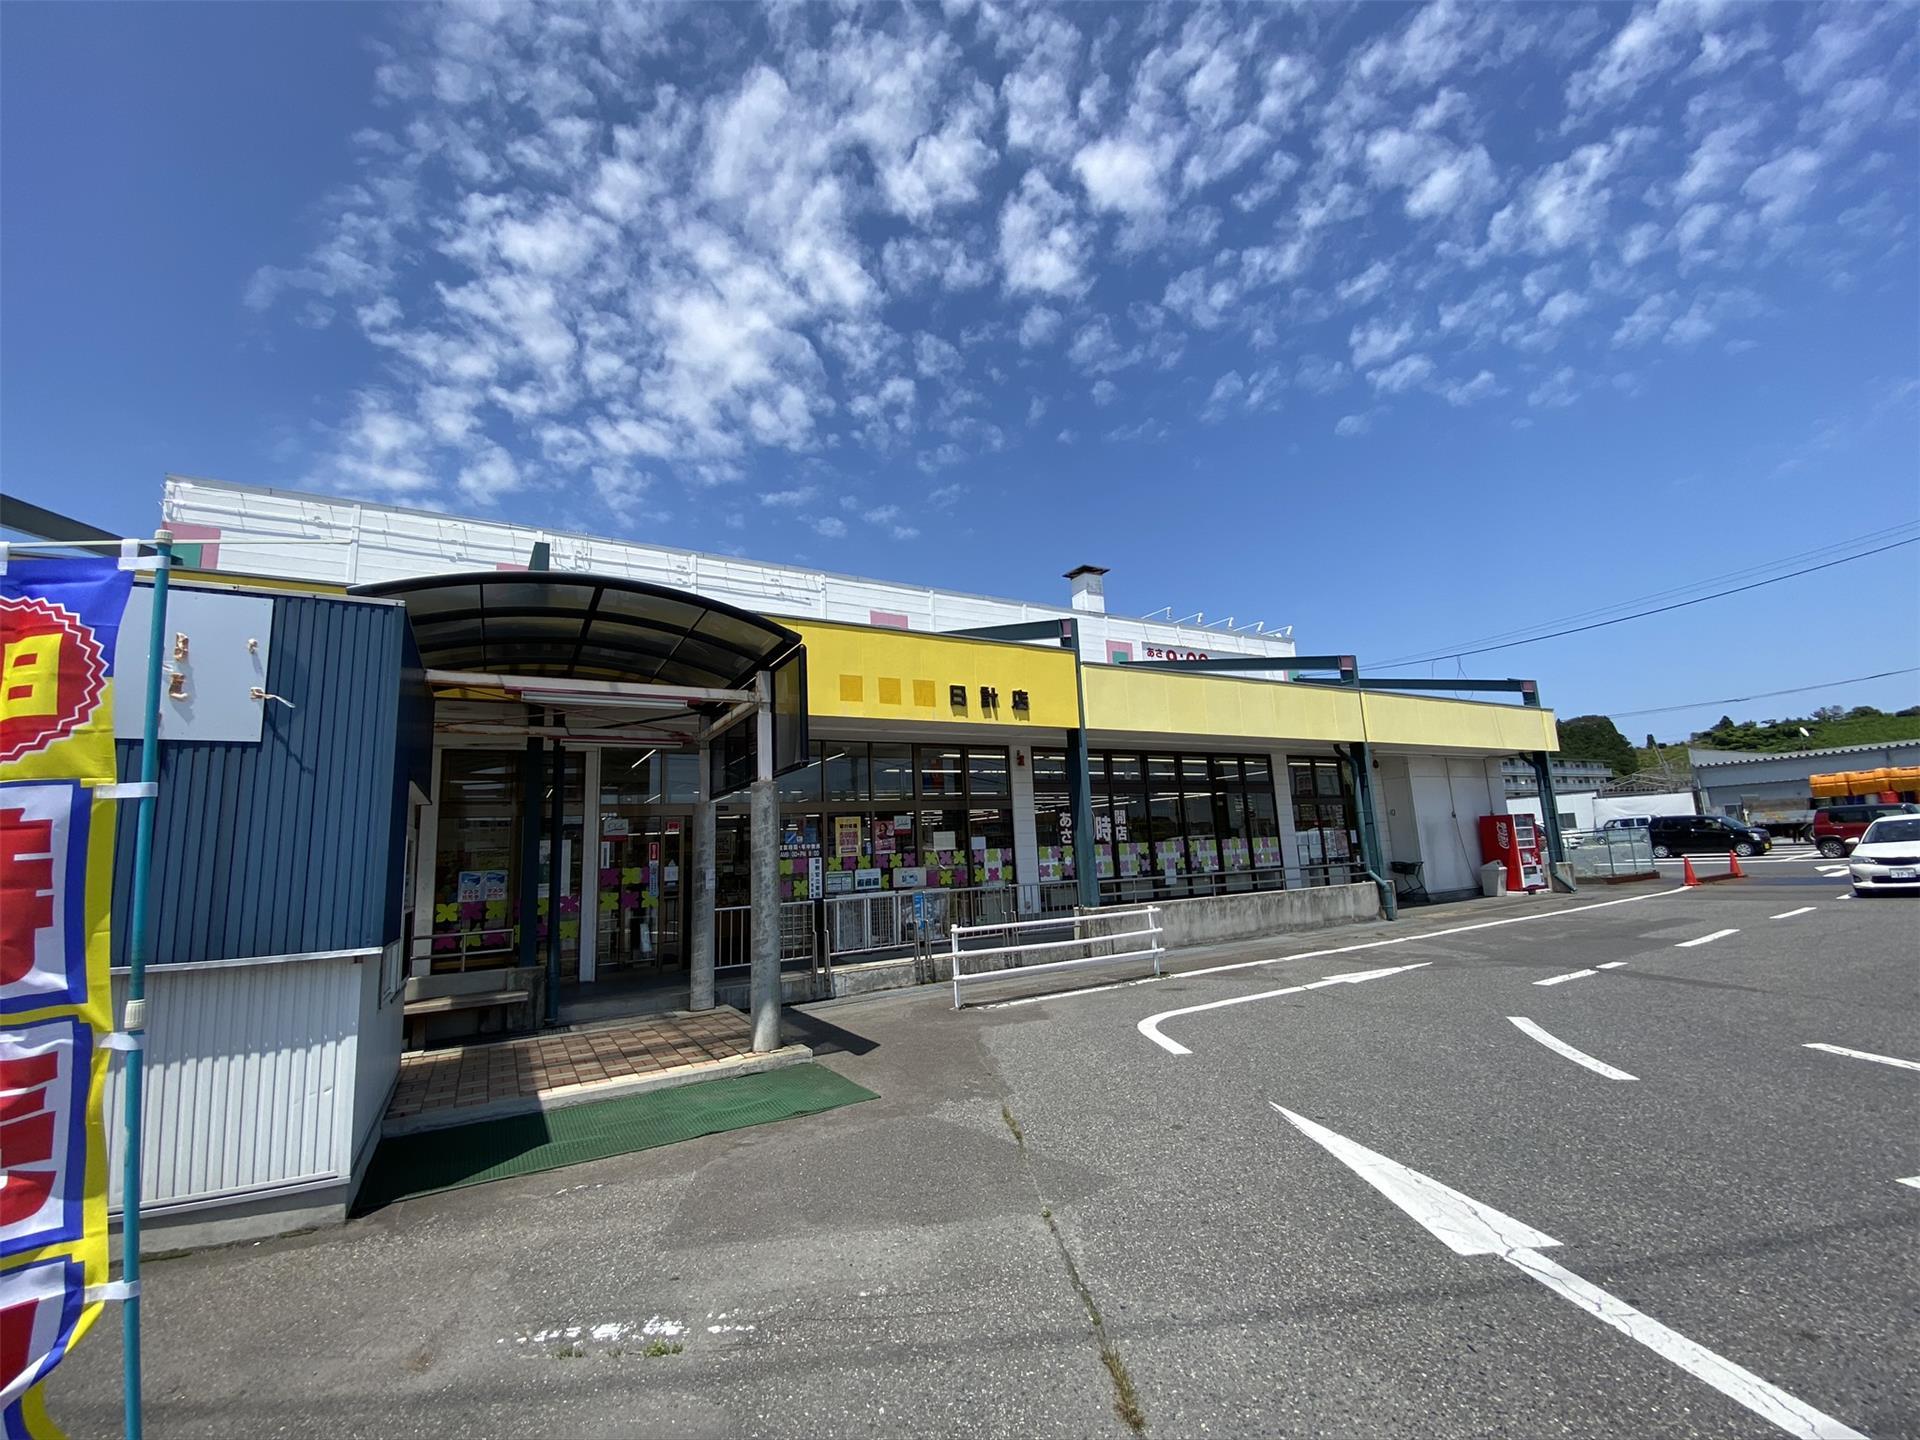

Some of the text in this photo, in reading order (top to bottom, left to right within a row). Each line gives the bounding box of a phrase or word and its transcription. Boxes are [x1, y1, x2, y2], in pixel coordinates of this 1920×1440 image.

[1146, 647, 1163, 658] あさ
[949, 685, 1030, 711] 日計店
[1060, 811, 1073, 844] あさ
[1096, 816, 1112, 842] 時
[1114, 809, 1128, 841] 開店
